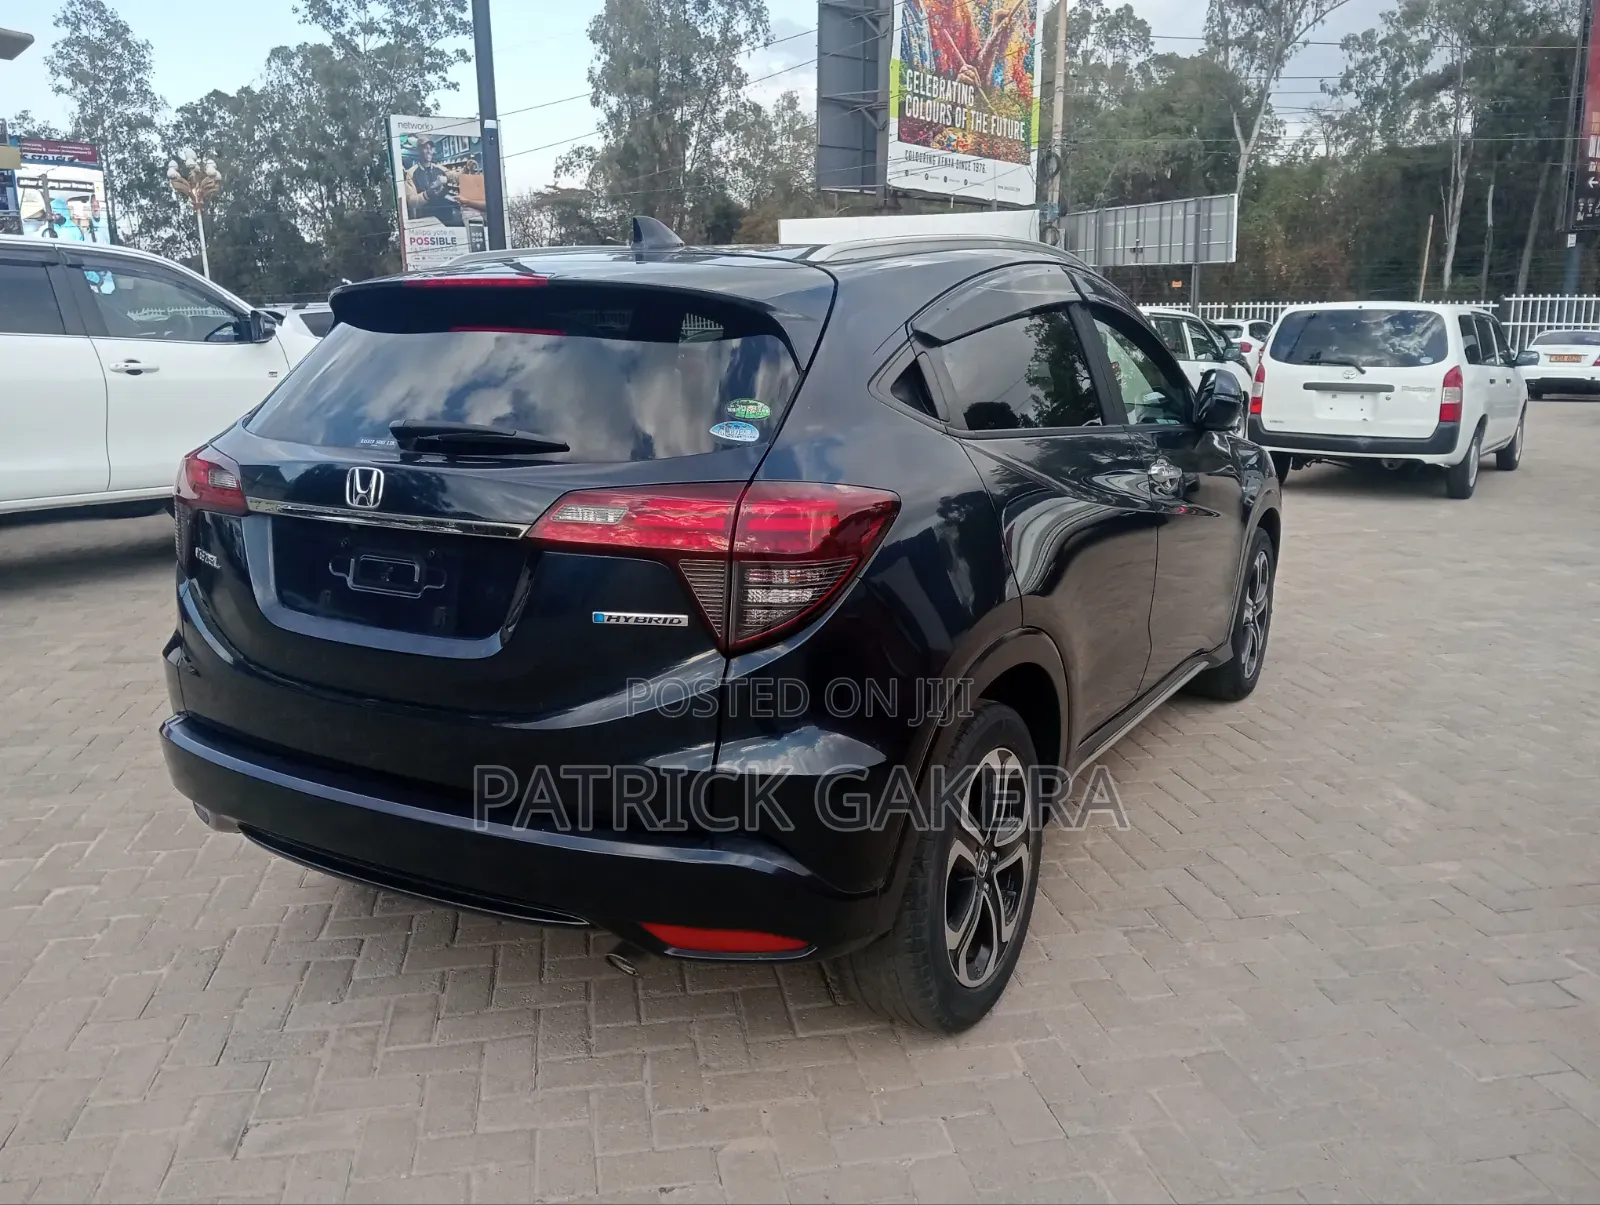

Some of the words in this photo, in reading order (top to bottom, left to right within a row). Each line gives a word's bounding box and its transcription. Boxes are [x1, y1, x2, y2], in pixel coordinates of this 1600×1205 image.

[906, 69, 975, 106] CELEBRATING
[905, 95, 951, 125] COLOURS
[954, 107, 967, 129] OF
[971, 111, 988, 133] THE
[991, 115, 1026, 141] FUTURE
[397, 121, 430, 130] network
[410, 237, 457, 246] POSSIBLE
[606, 615, 682, 625] HYBRID
